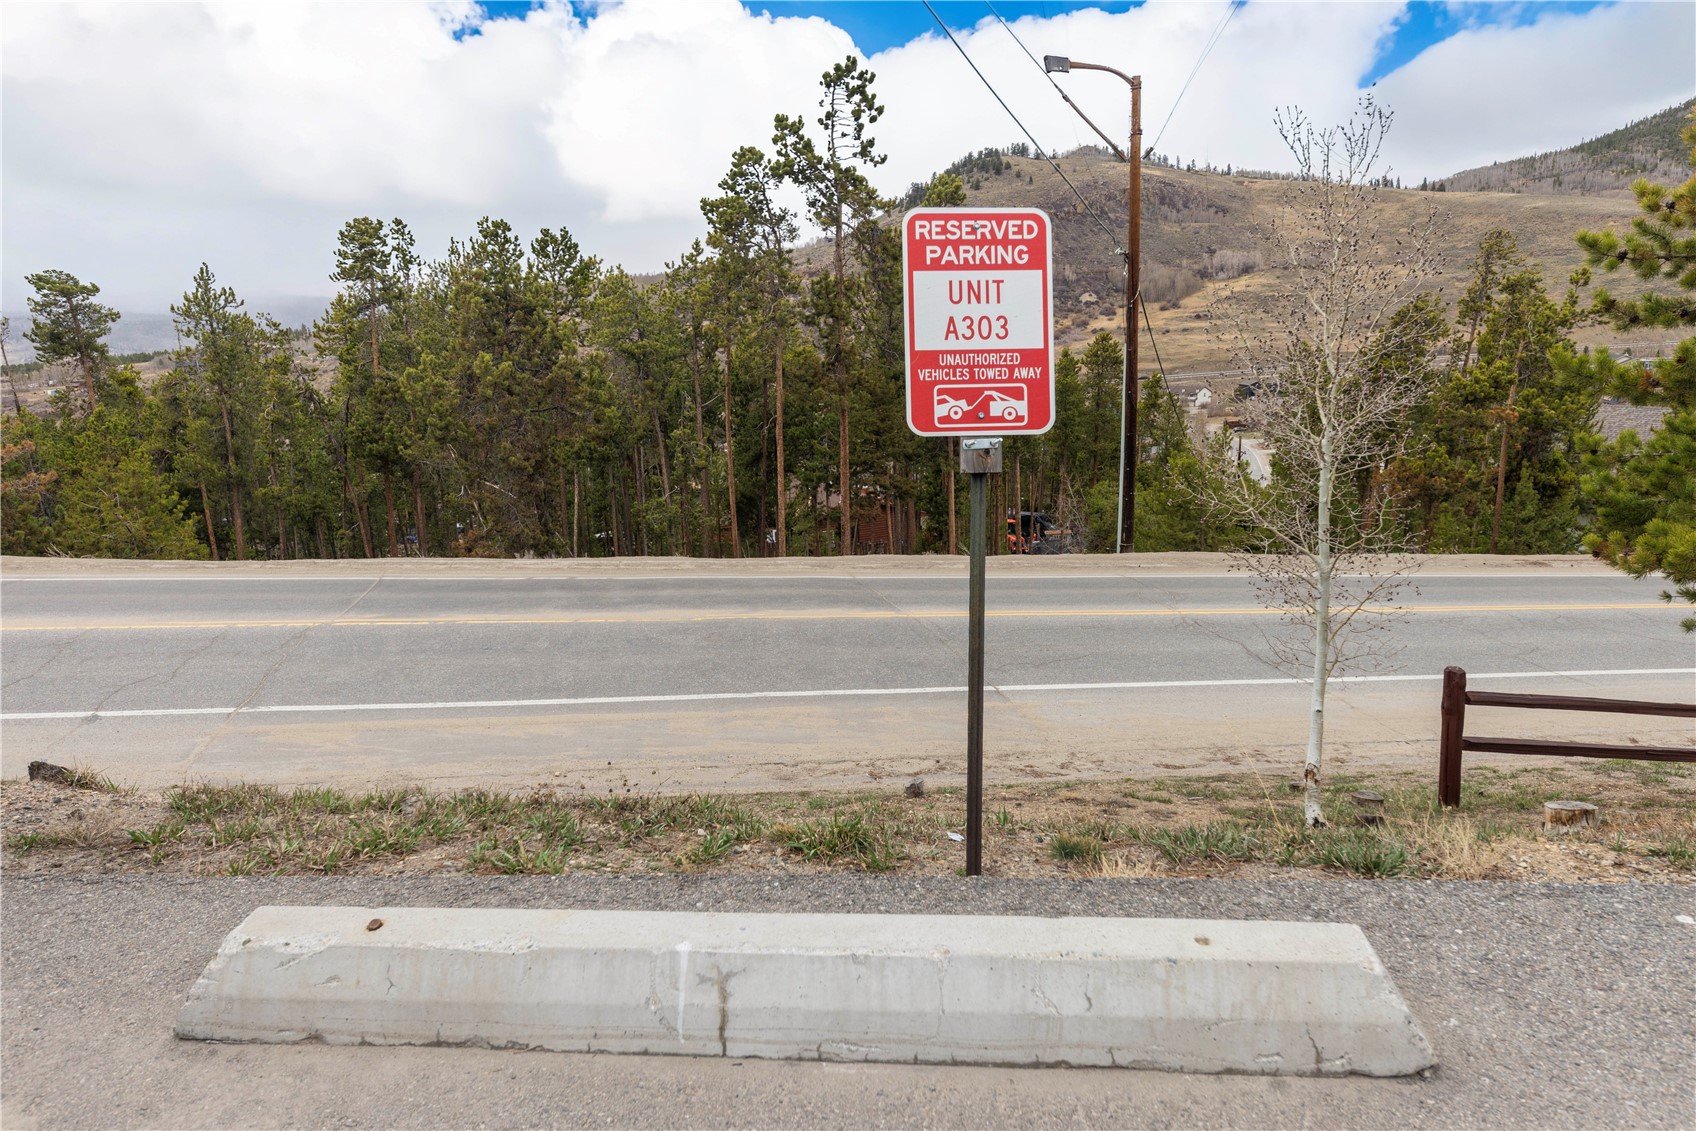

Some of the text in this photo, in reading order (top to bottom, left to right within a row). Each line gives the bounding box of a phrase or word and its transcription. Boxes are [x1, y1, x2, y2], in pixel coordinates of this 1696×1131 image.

[915, 220, 1039, 240] RESERVED
[926, 245, 1029, 265] PARKING
[948, 279, 1005, 305] UNIT
[944, 315, 1010, 341] A303
[939, 352, 1021, 366] UNAUTHORIZED
[918, 367, 1042, 381] VEHICLES TOWED AWAY
